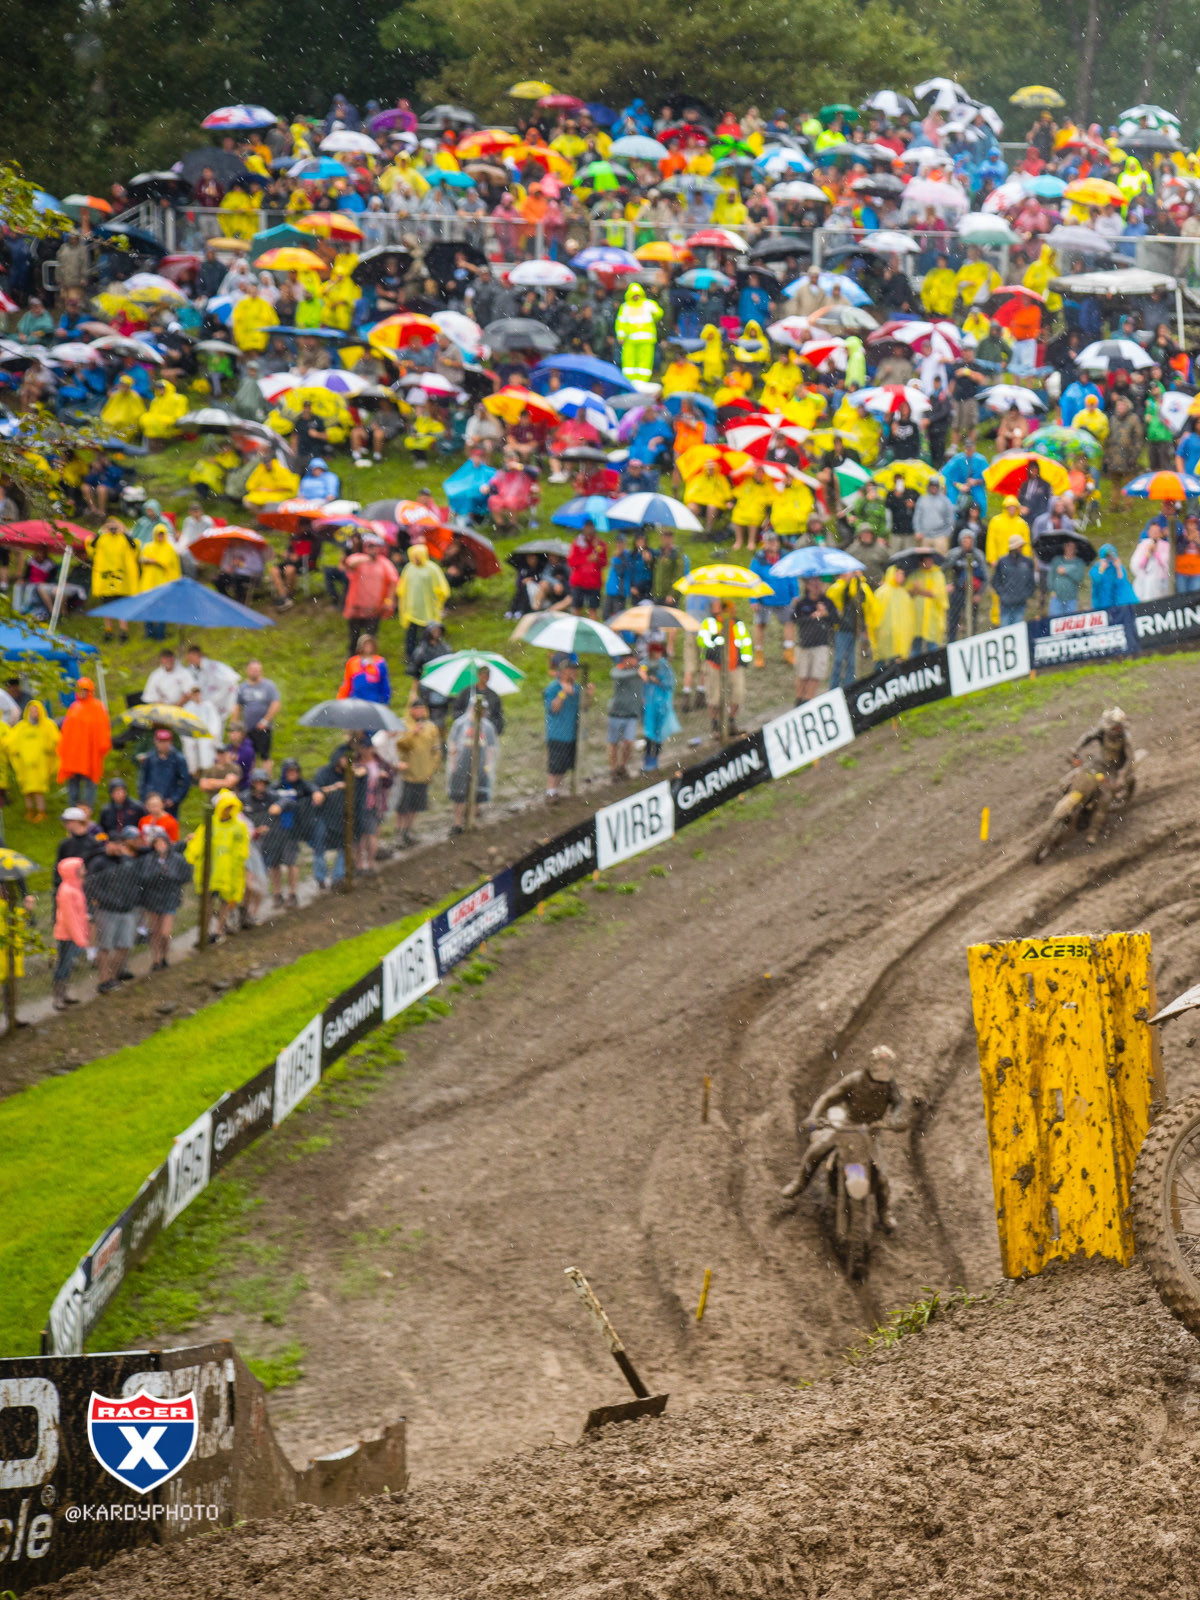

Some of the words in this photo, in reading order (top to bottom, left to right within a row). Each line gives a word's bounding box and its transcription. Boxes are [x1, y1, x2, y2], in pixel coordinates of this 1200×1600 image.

[959, 634, 1018, 683] VIRB
[856, 665, 945, 716] GARMIN
[775, 703, 839, 761] VIRB
[677, 749, 762, 810] GARMIN
[606, 796, 662, 852] VIRB
[521, 836, 592, 895] GARMIN
